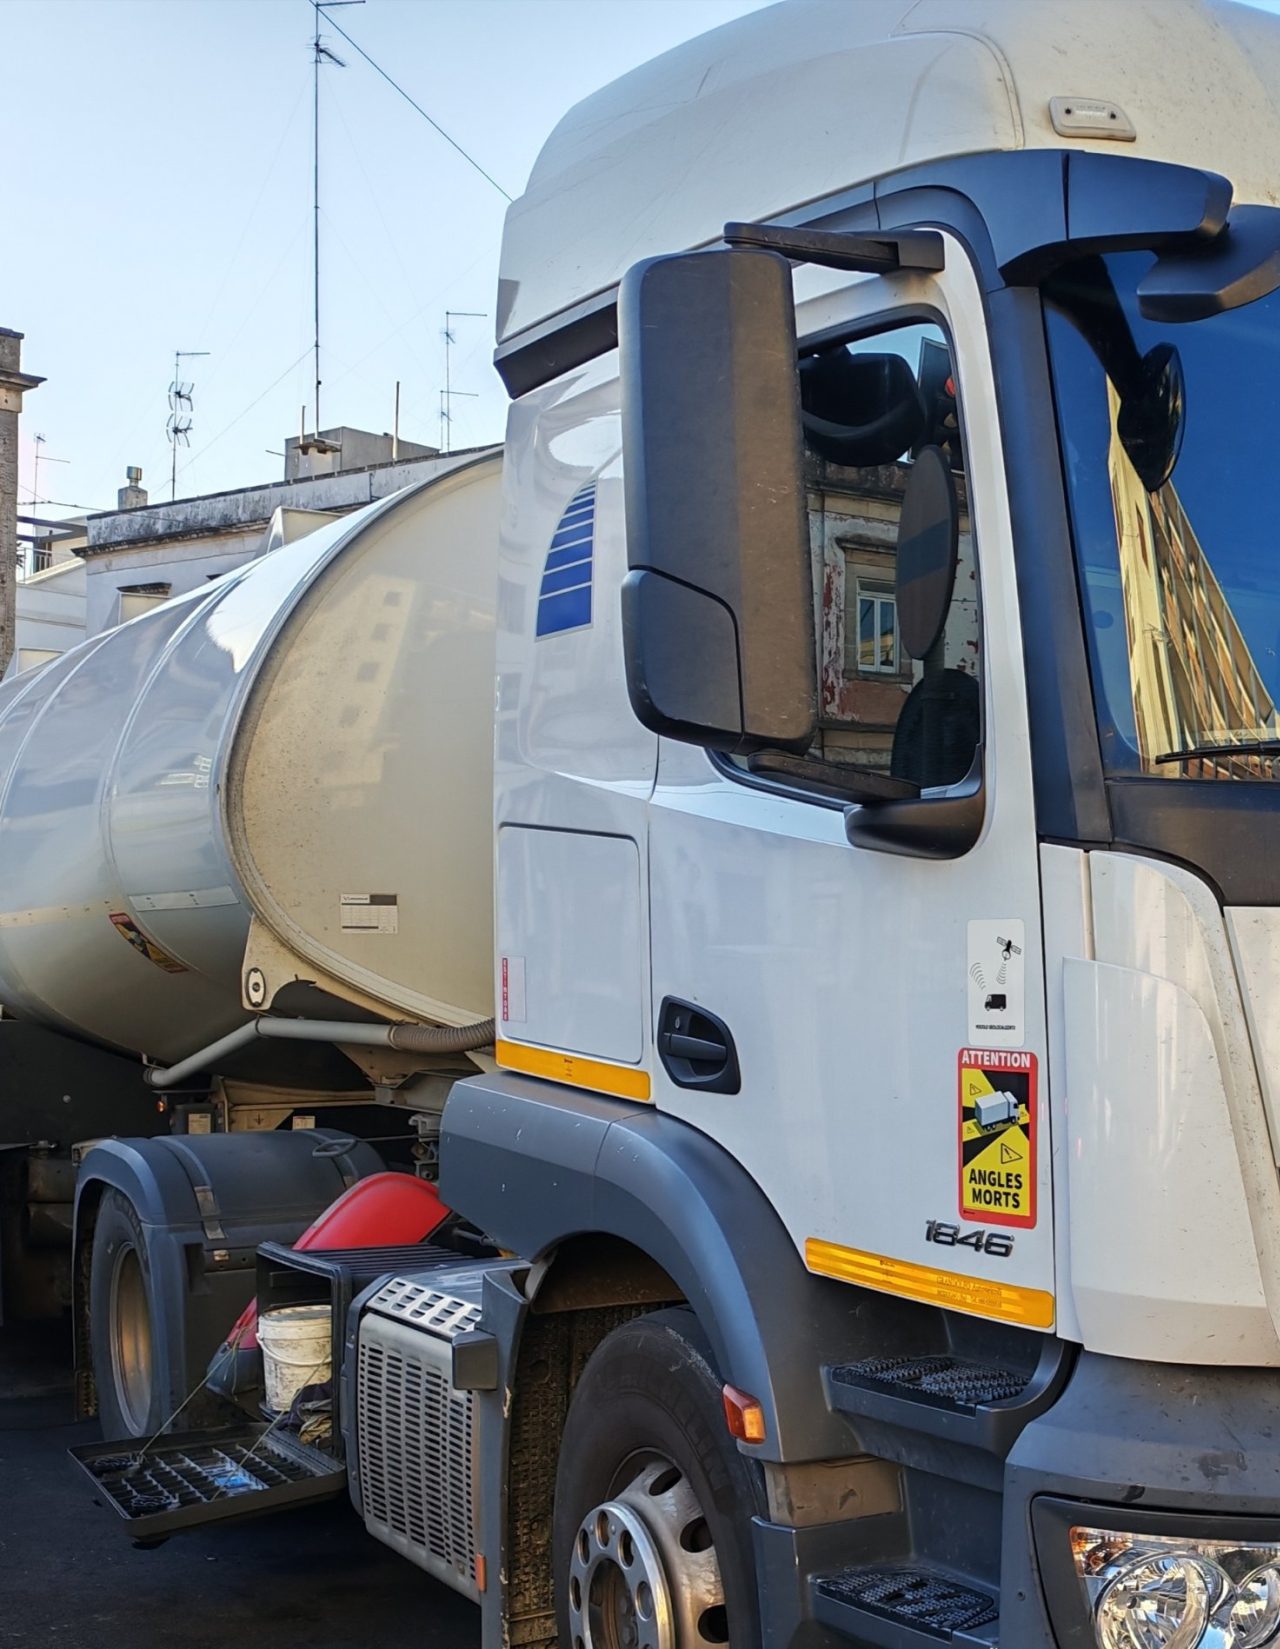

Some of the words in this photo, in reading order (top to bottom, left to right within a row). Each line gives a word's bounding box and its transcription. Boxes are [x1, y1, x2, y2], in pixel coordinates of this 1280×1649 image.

[961, 1049, 1031, 1068] ATTENTION
[969, 1168, 1023, 1190] ANGLES
[972, 1187, 1020, 1209] MORTS
[926, 1219, 1015, 1258] 1846
